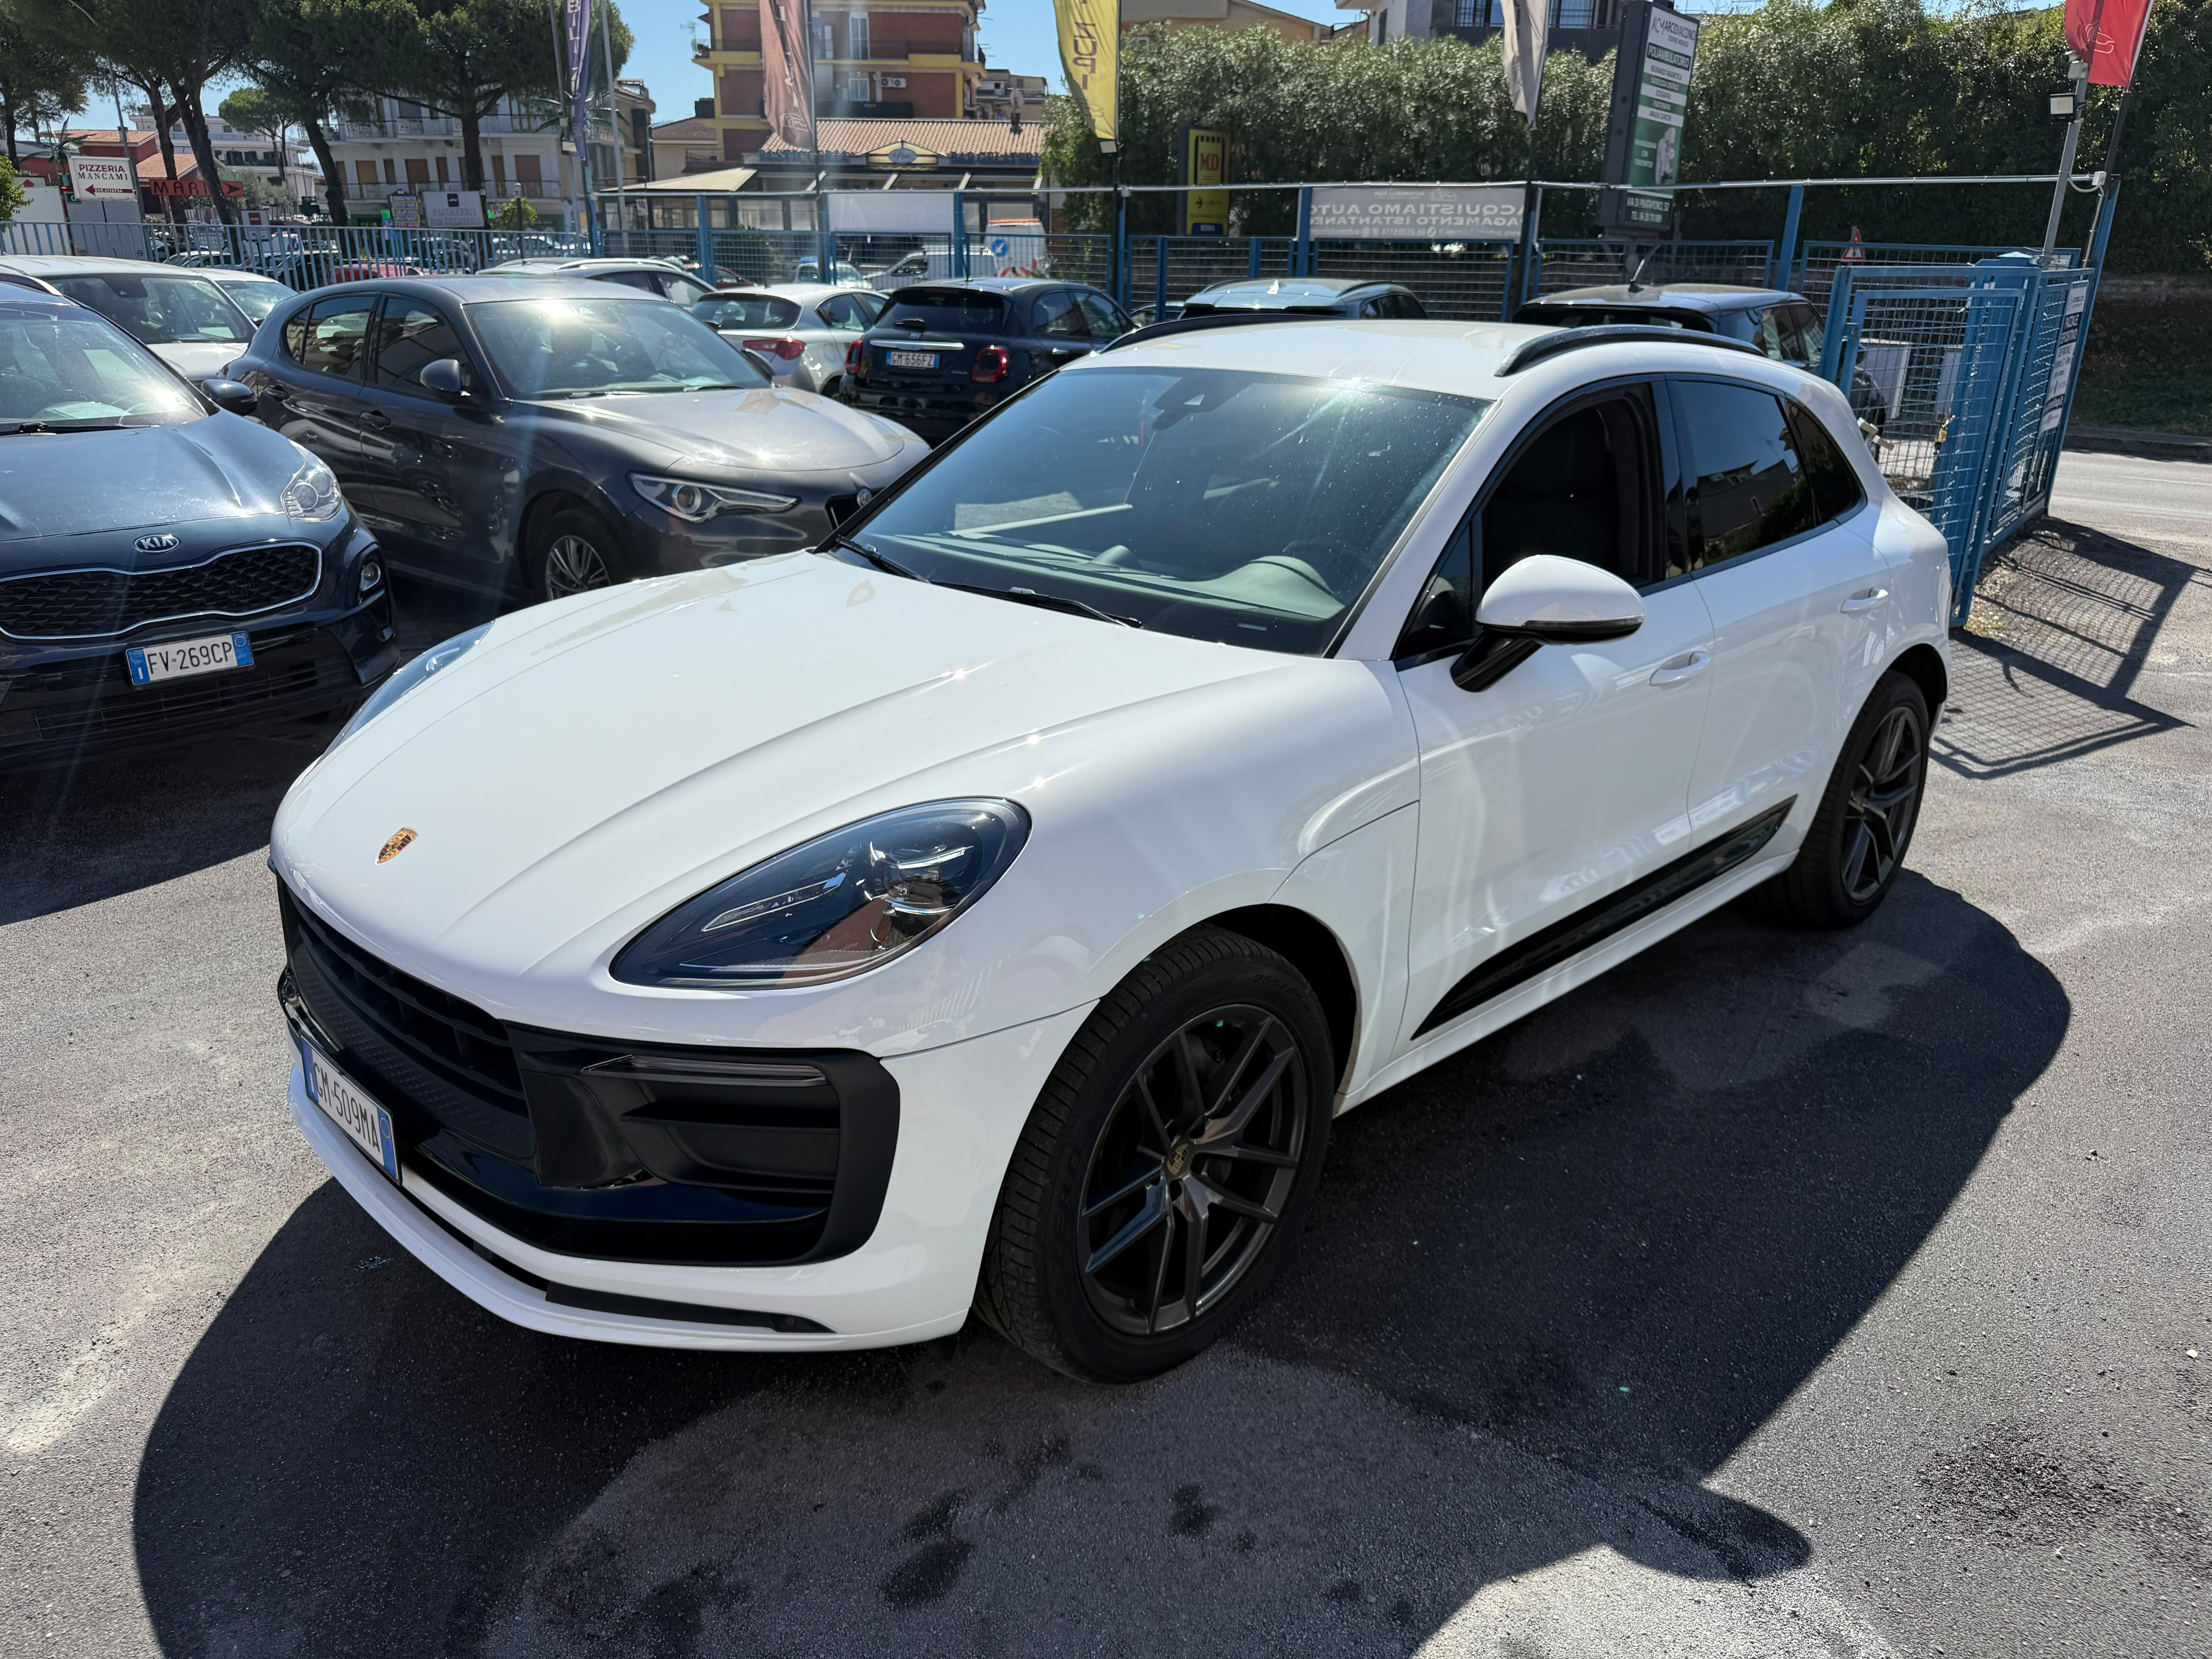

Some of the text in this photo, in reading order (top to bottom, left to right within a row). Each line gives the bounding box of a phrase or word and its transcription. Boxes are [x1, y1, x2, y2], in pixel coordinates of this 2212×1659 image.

[1648, 44, 1690, 68] POLIAMBULATORIO
[79, 164, 125, 173] PIZZERIA
[78, 172, 128, 180] MANCAMI
[153, 181, 207, 194] MARI
[906, 354, 934, 367] 656FZ
[140, 536, 174, 549] KIA
[147, 642, 232, 674] FV 269CP
[334, 1080, 381, 1153] 509MA
